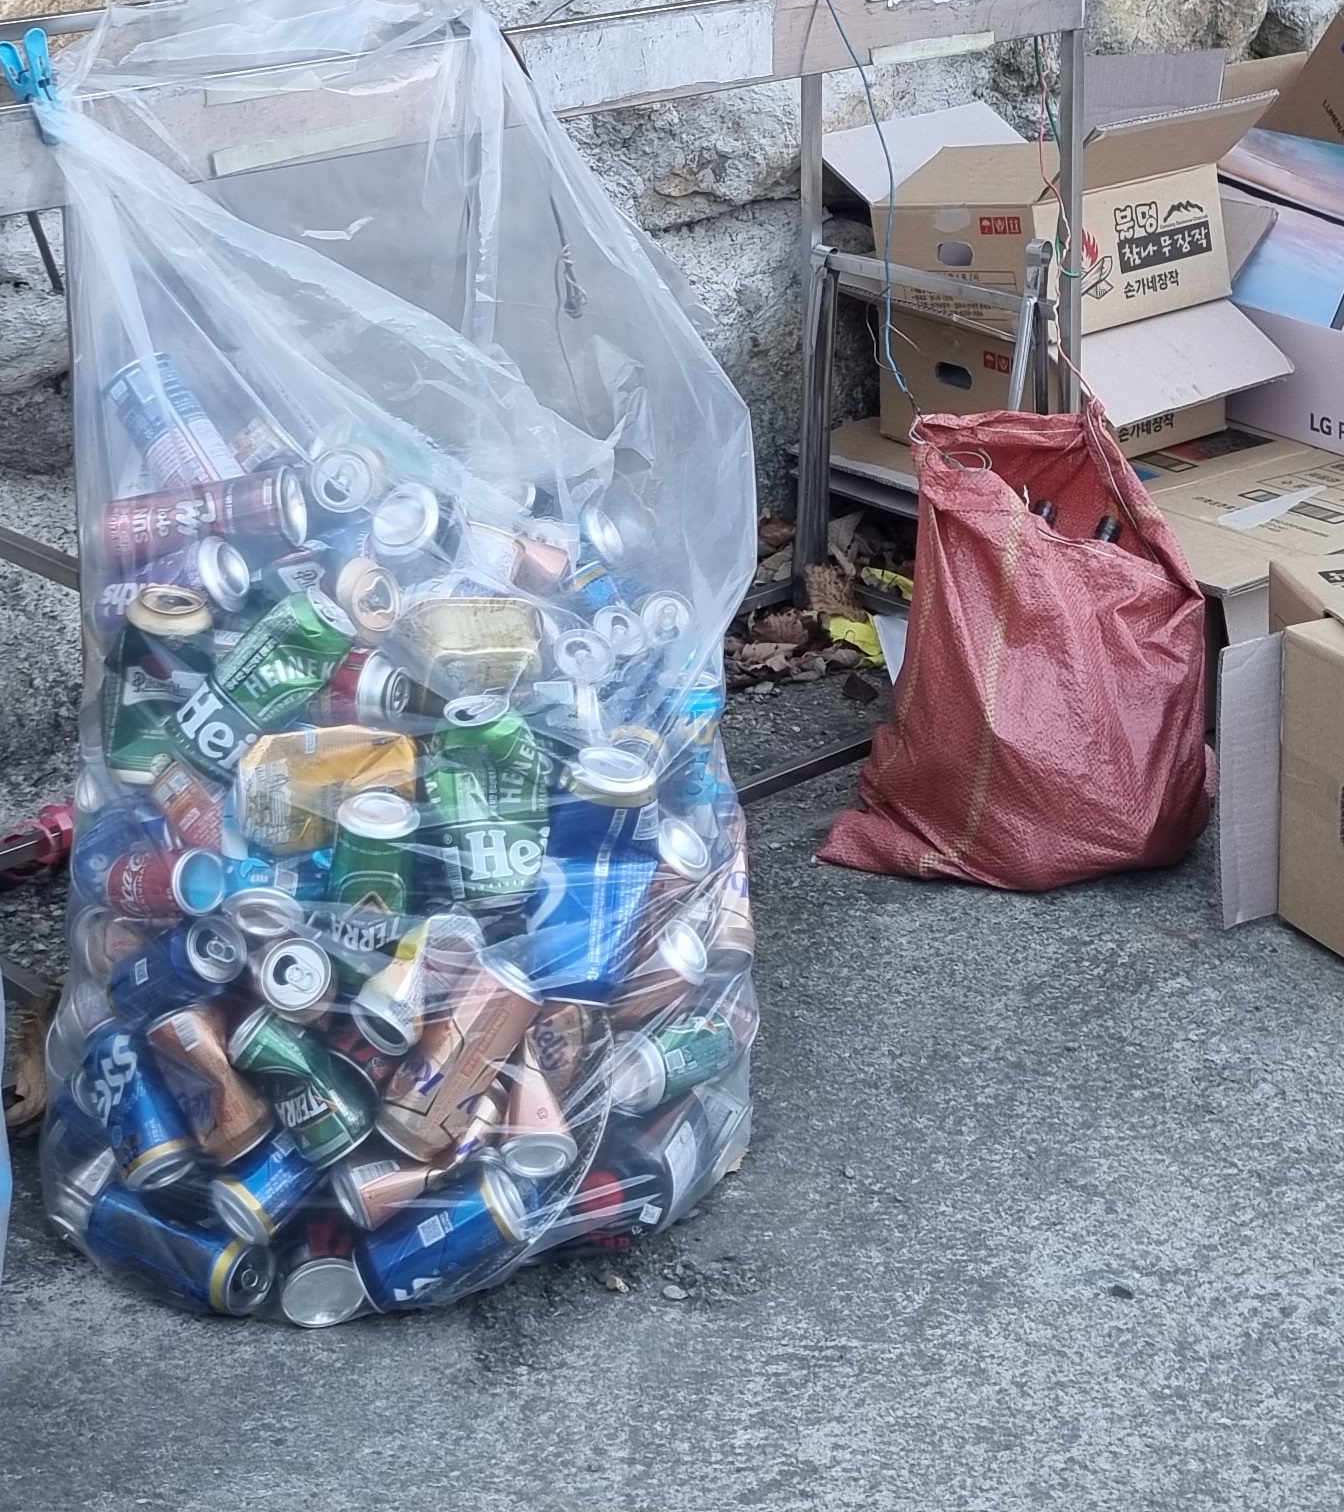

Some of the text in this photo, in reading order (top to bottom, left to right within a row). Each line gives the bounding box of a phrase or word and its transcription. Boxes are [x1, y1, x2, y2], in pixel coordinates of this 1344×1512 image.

[1123, 269, 1180, 299] 손가네장작
[1118, 413, 1174, 443] 손가네장작
[1310, 413, 1332, 435] LG
[331, 915, 403, 952] TERRA
[274, 1086, 328, 1128] TERRA
